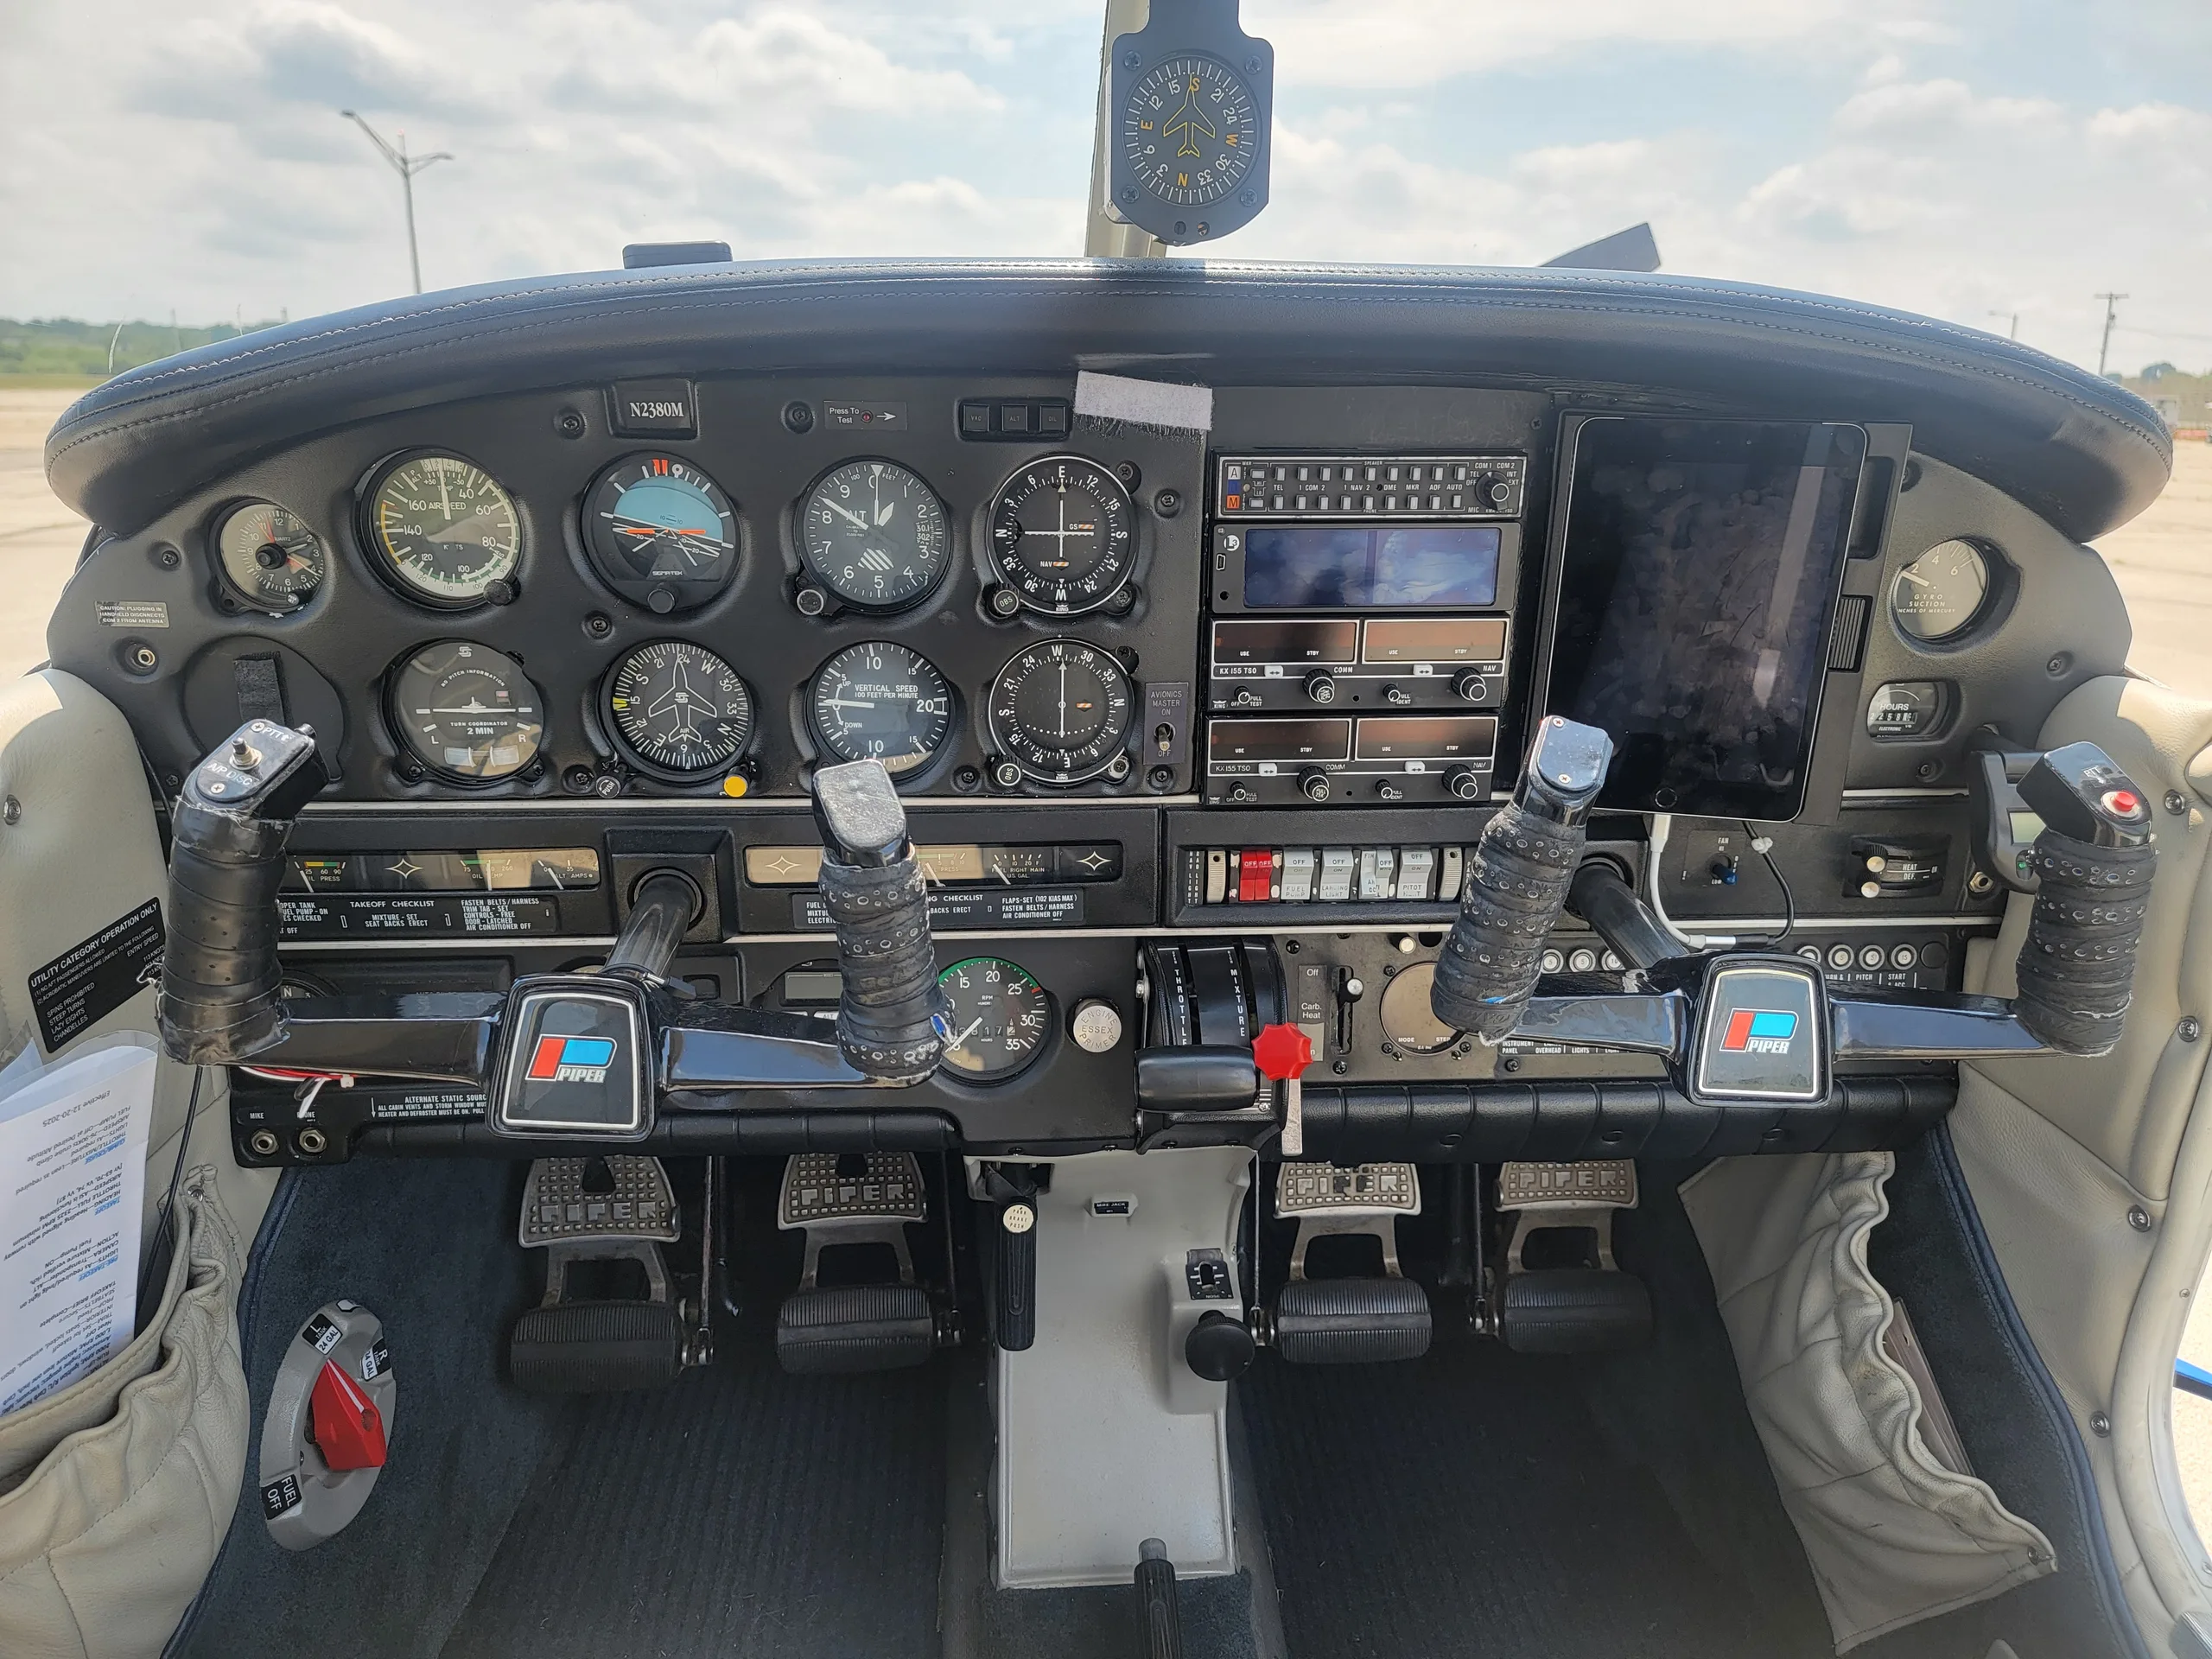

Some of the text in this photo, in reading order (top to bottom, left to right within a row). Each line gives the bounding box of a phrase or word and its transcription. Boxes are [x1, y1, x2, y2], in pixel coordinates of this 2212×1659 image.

[1168, 79, 1180, 95] 15
[1192, 78, 1200, 92] S
[1211, 88, 1224, 104] 21
[1149, 95, 1163, 111] 12
[1223, 107, 1237, 124] 24
[1141, 119, 1153, 130] E
[1225, 134, 1239, 147] W
[1215, 154, 1231, 170] 30
[1178, 173, 1189, 187] N
[1198, 169, 1213, 186] 33
[629, 402, 684, 418] N2380M
[1058, 466, 1065, 478] E
[459, 489, 474, 499] 40
[839, 485, 850, 499] 9
[409, 500, 426, 511] 160
[476, 505, 491, 516] 60
[917, 505, 928, 518] 2
[822, 511, 833, 524] 8
[404, 525, 422, 536] 140
[995, 529, 1007, 538] N
[1116, 531, 1128, 539] S
[482, 537, 496, 547] 80
[822, 541, 832, 554] 7
[919, 546, 930, 559] 3
[843, 565, 855, 579] 6
[874, 575, 884, 588] 5
[1000, 595, 1014, 607] OBS
[1055, 588, 1067, 601] W
[1052, 645, 1063, 656] W
[701, 660, 716, 675] W
[866, 657, 882, 670] 10
[448, 671, 465, 681] PITCH
[467, 670, 505, 687] INFORMATION
[916, 700, 934, 713] 20
[262, 727, 282, 739] PTT
[717, 722, 733, 735] N
[431, 735, 439, 744] L
[226, 770, 253, 785] DISC
[1004, 766, 1014, 781] OBS
[601, 781, 615, 796] PUSH
[30, 902, 158, 988] UTILITY CATEGORY OPERATION ONLY
[127, 932, 159, 957] ENTRY SPEED
[985, 970, 1001, 982] 20
[1856, 973, 1873, 982] PITCH
[1887, 972, 1906, 981] START
[1007, 983, 1022, 995] 25
[47, 982, 95, 1018] SPINS PROHIBITED
[1230, 969, 1245, 1037] MIXTURE
[1301, 1002, 1322, 1011] Carb.
[1020, 1014, 1036, 1027] 30
[1080, 1008, 1118, 1026] ENGINE
[1081, 1025, 1113, 1034] ESSEX
[1079, 1033, 1116, 1049] PRIMER
[1747, 1040, 1789, 1054] PIPER
[557, 1067, 607, 1083] PIPER
[82, 1090, 111, 1109] Effective
[404, 1094, 464, 1103] ALTERNATE STATIC
[319, 1329, 339, 1351] 24 GAL
[281, 1476, 297, 1507] FUEL
[267, 1488, 282, 1510] OFF
